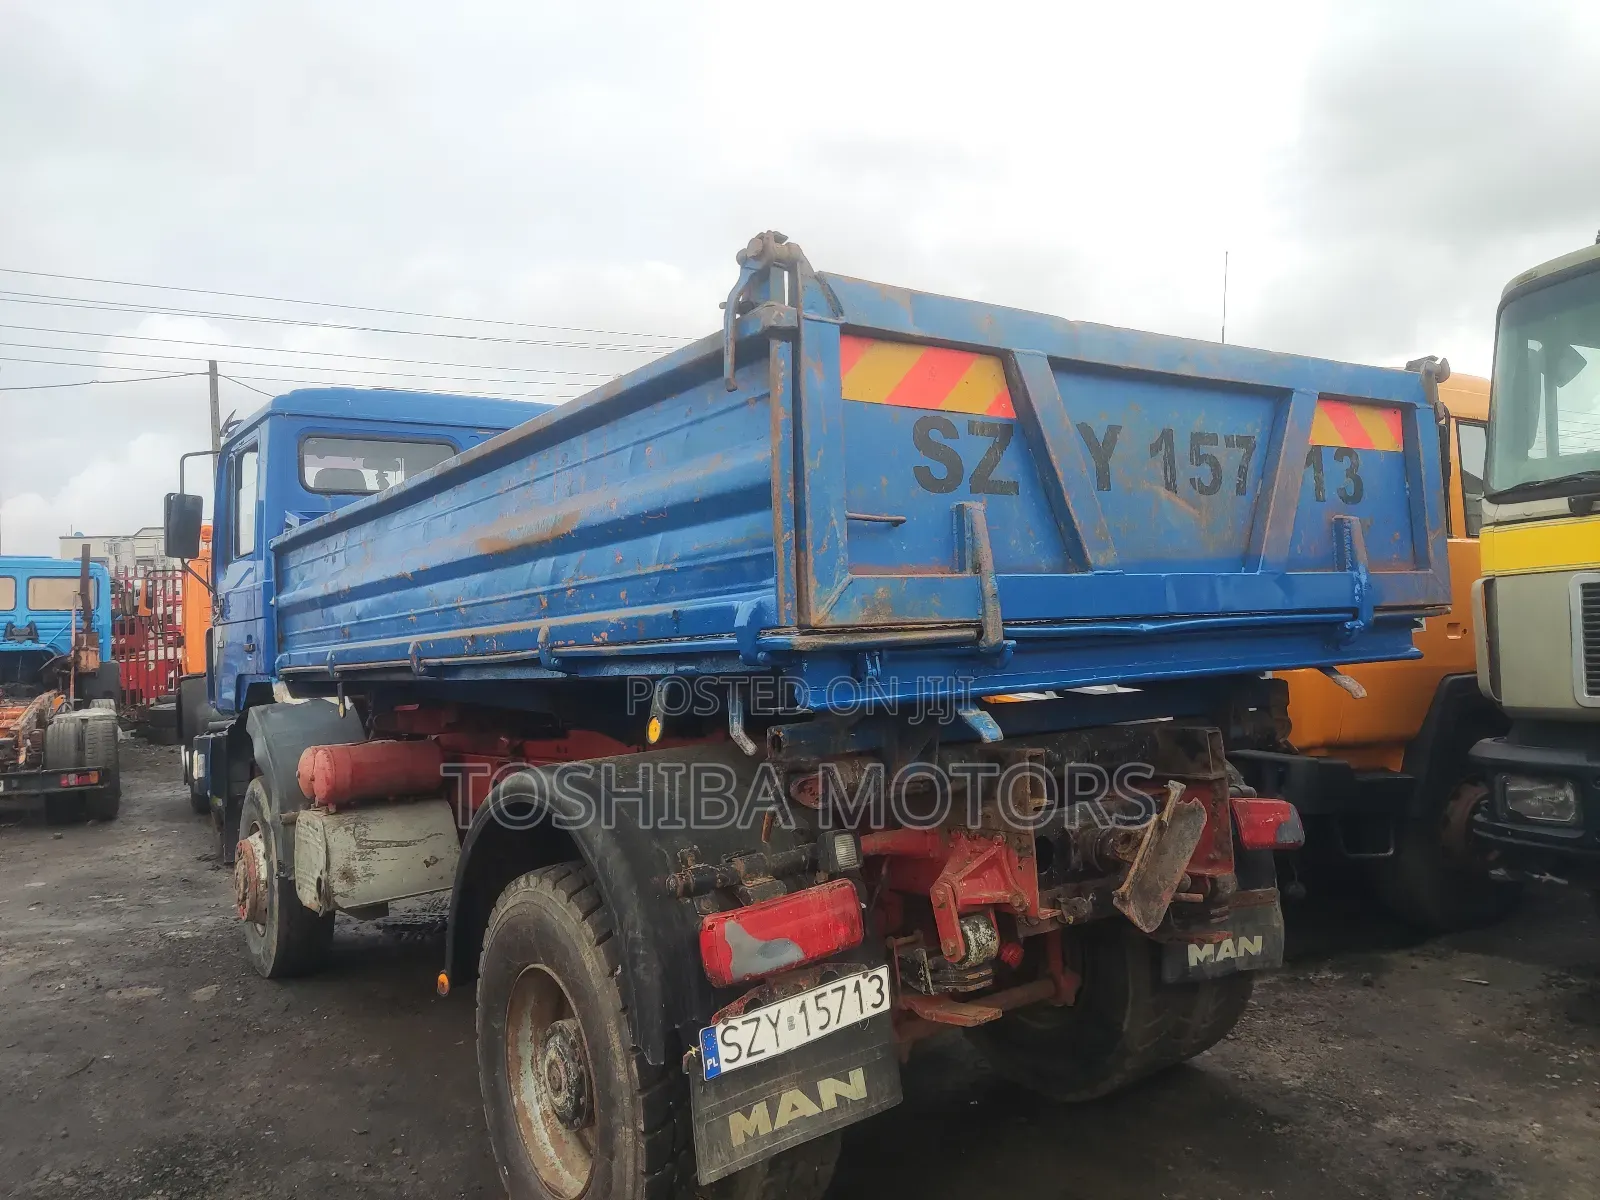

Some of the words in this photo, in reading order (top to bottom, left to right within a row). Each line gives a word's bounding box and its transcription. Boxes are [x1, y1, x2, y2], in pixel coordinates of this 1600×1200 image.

[912, 415, 1020, 497] SZ
[1149, 427, 1257, 497] 157
[1303, 445, 1364, 505] 13
[1187, 935, 1263, 967] MAN
[720, 1009, 782, 1064] SZY
[798, 974, 885, 1037] 15713
[706, 1056, 719, 1070] PL
[728, 1066, 868, 1148] MAN
